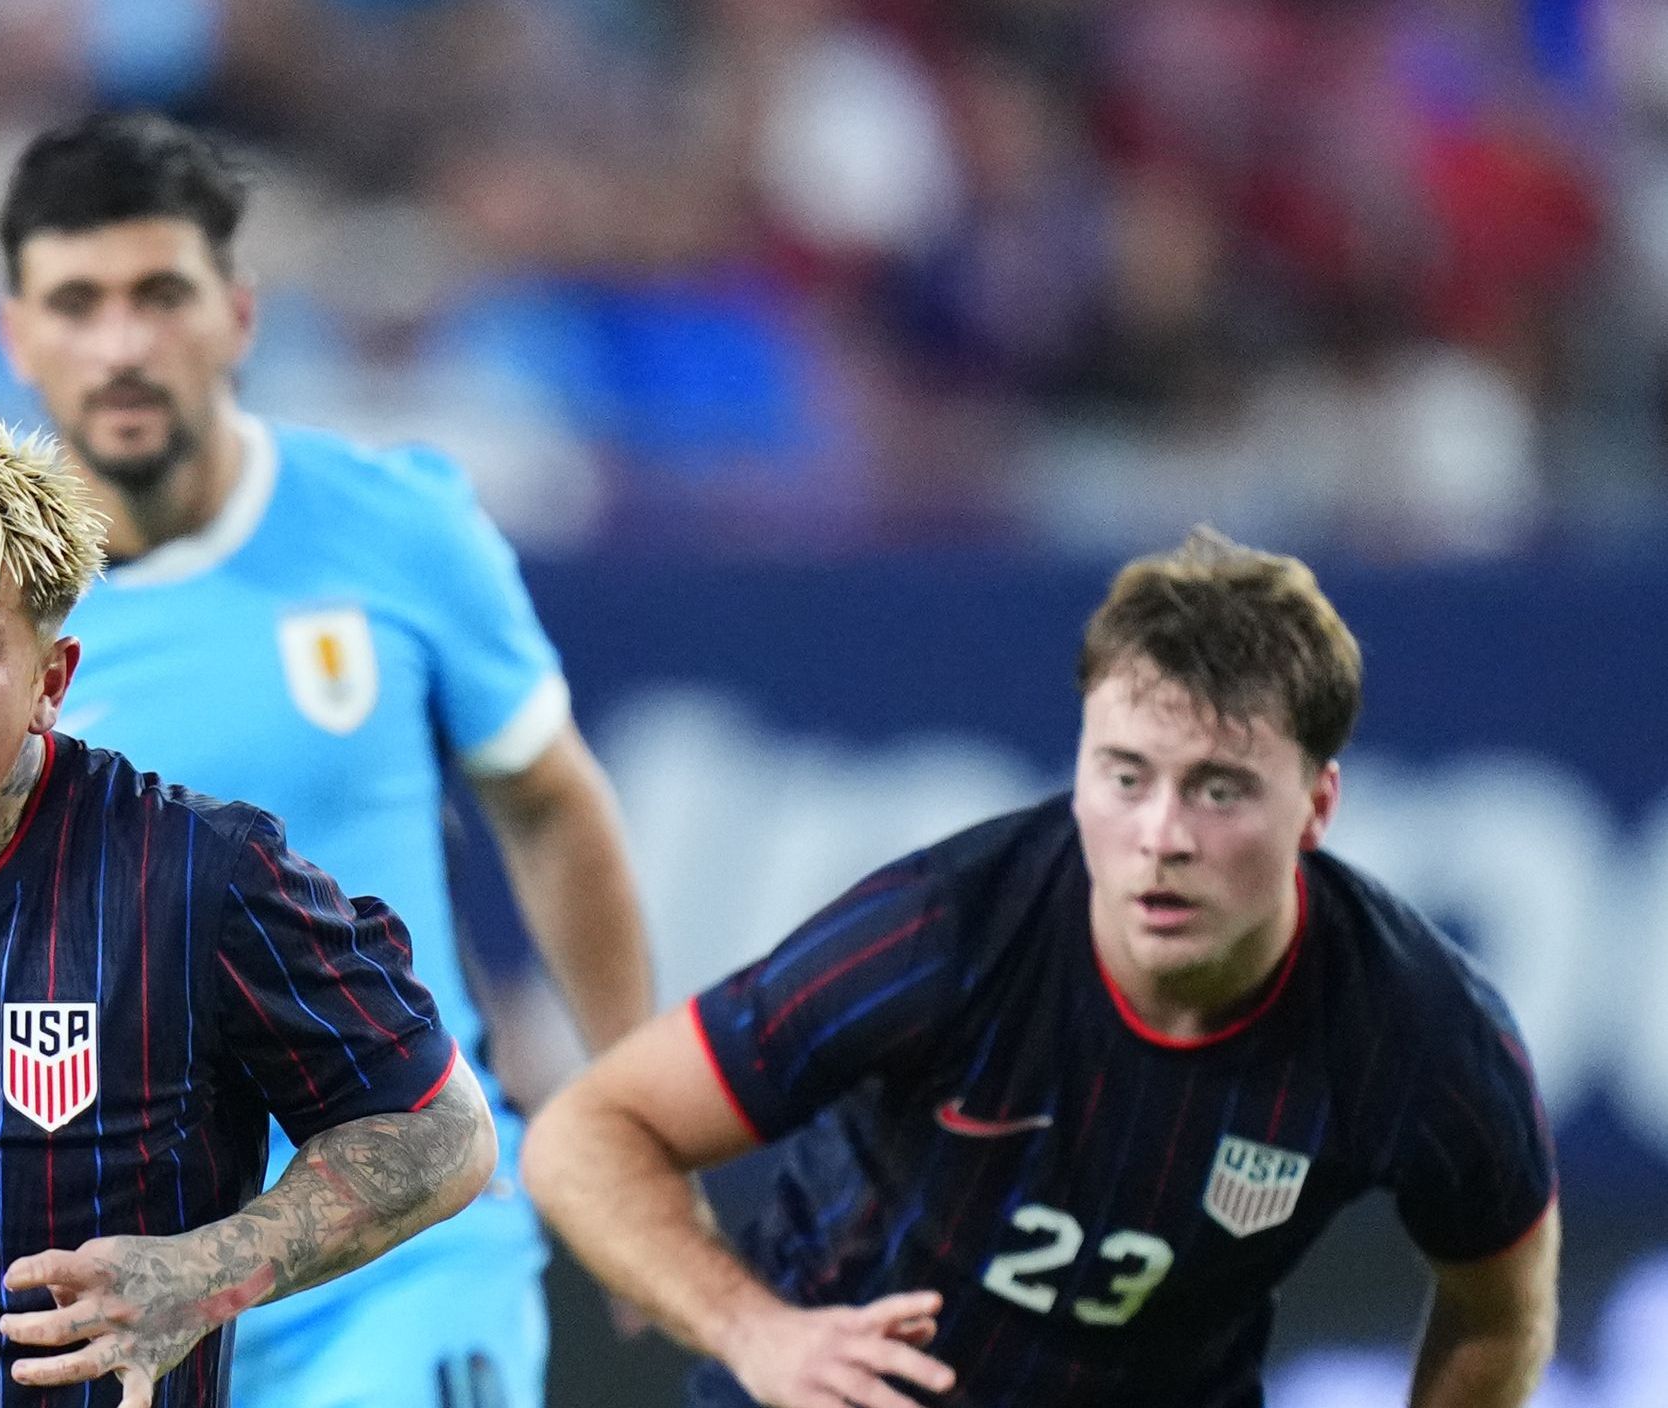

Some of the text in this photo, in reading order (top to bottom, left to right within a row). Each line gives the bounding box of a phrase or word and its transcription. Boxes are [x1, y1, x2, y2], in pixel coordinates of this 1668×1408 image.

[10, 1010, 90, 1057] USA
[1223, 1145, 1301, 1184] USA
[982, 1203, 1175, 1326] 23
